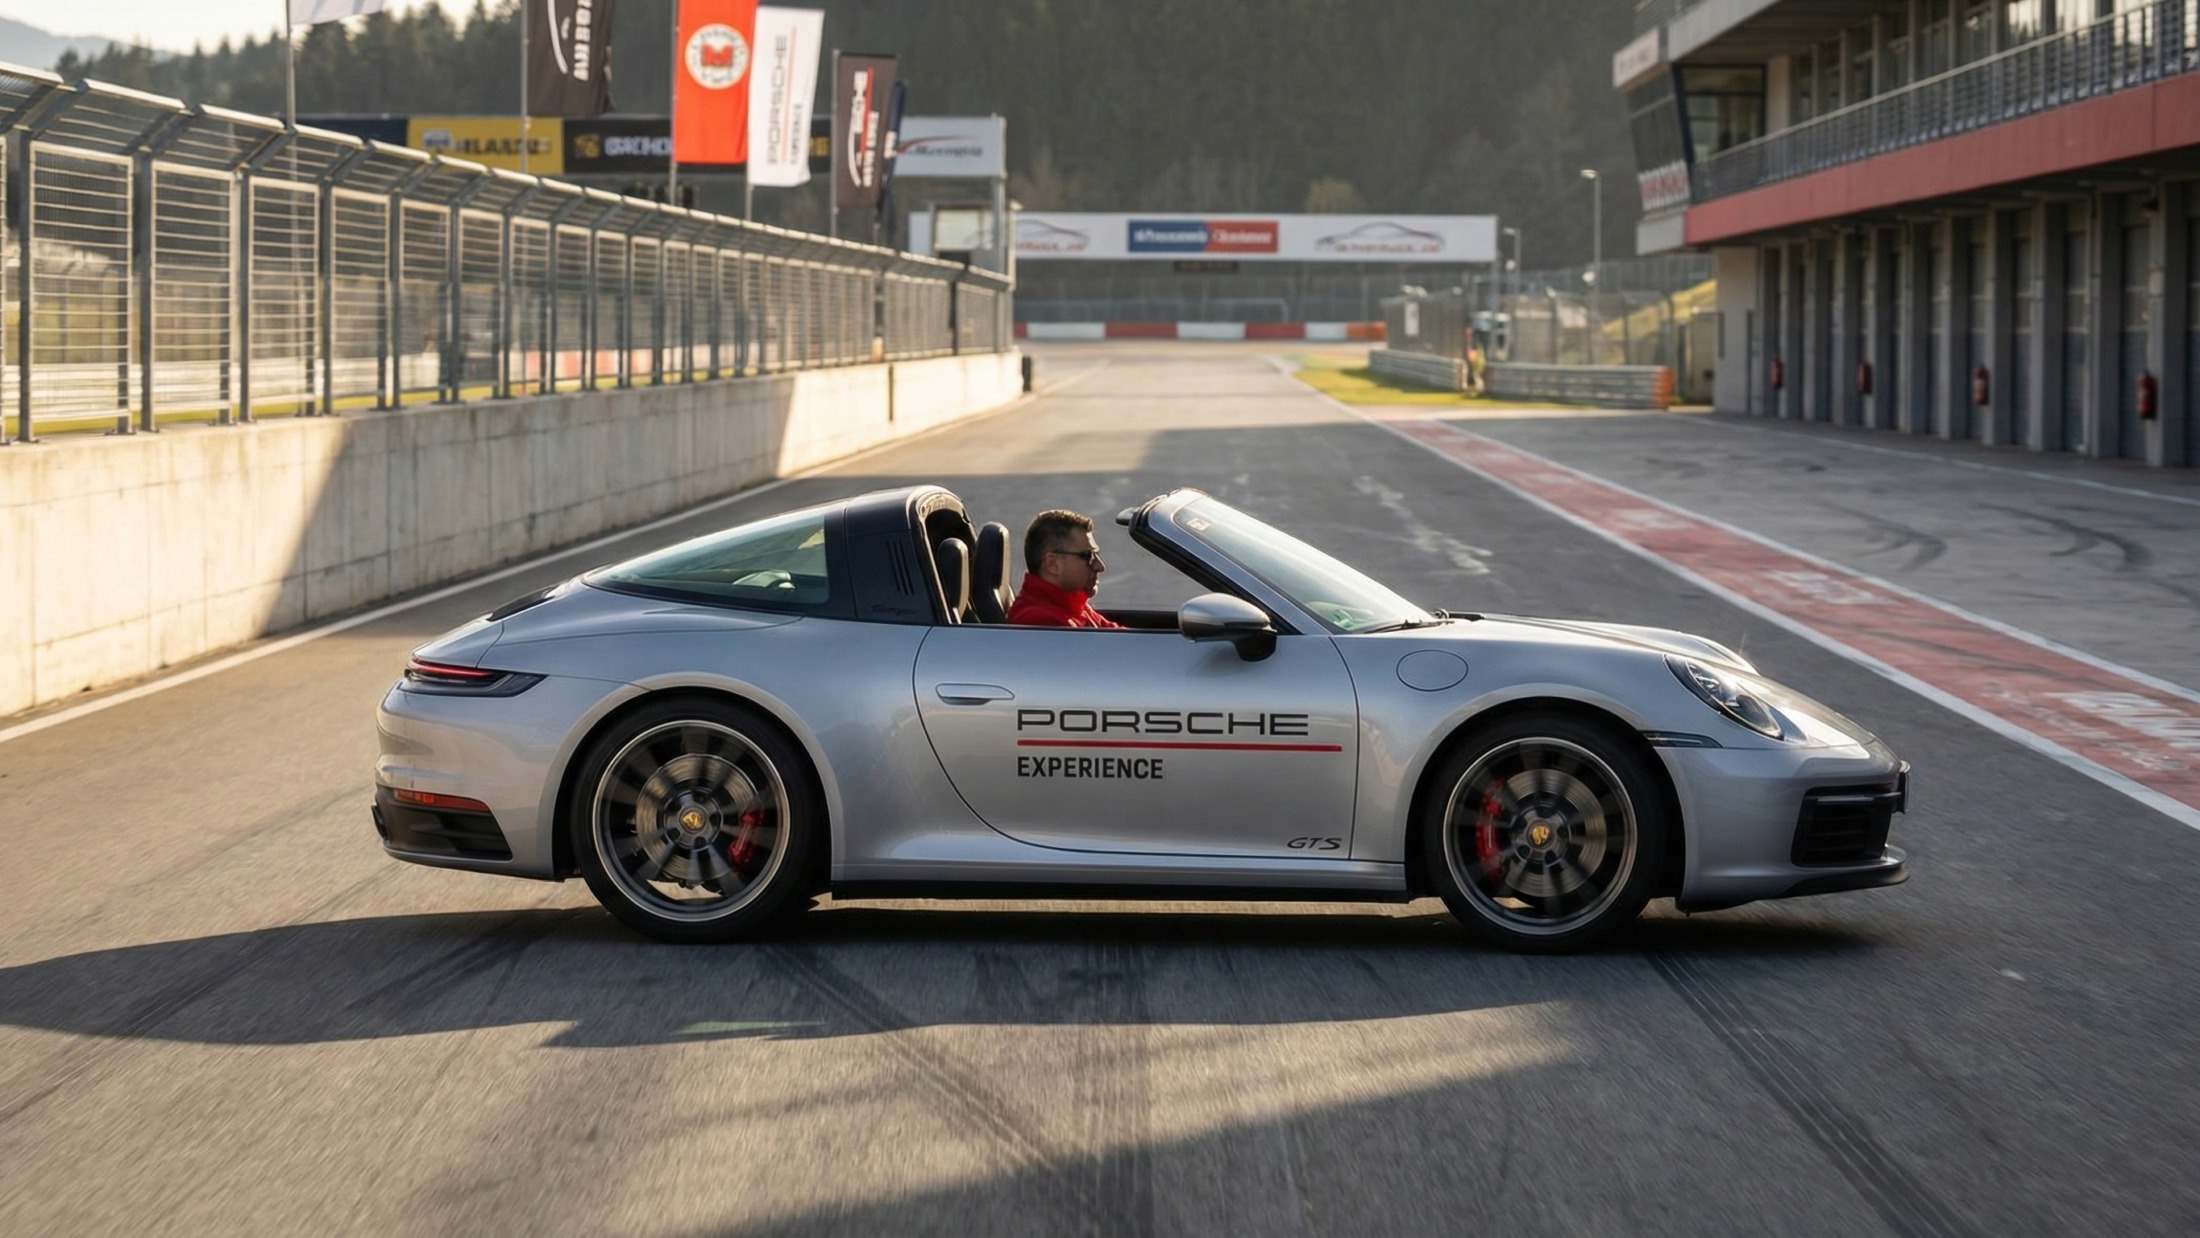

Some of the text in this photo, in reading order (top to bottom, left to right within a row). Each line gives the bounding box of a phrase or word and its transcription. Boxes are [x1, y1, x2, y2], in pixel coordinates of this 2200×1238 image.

[1017, 709, 1309, 736] PORSCHE
[1017, 756, 1164, 780] EXPERIENCE
[1287, 836, 1343, 851] GTS
